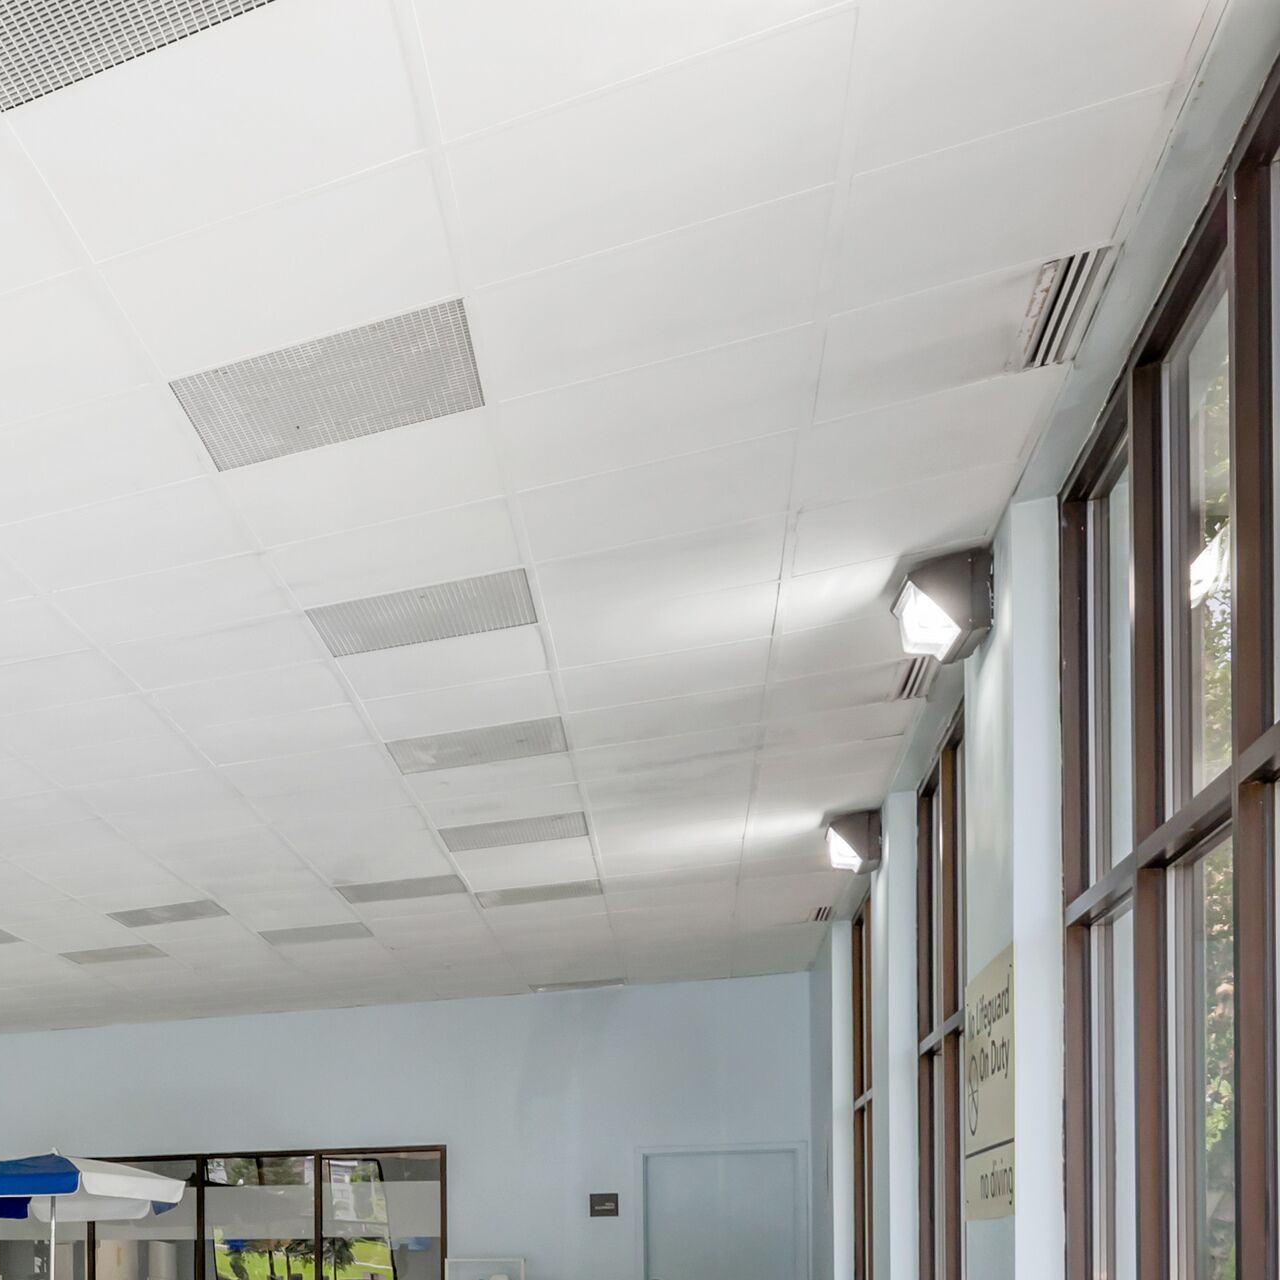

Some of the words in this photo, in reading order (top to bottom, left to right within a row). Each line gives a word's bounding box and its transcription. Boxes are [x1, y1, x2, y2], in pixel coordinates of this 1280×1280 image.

[976, 974, 1010, 1038] Lifeguard
[979, 1047, 990, 1082] On
[990, 1035, 1010, 1080] Duty
[980, 1173, 989, 1200] no
[990, 1158, 1014, 1206] diving
